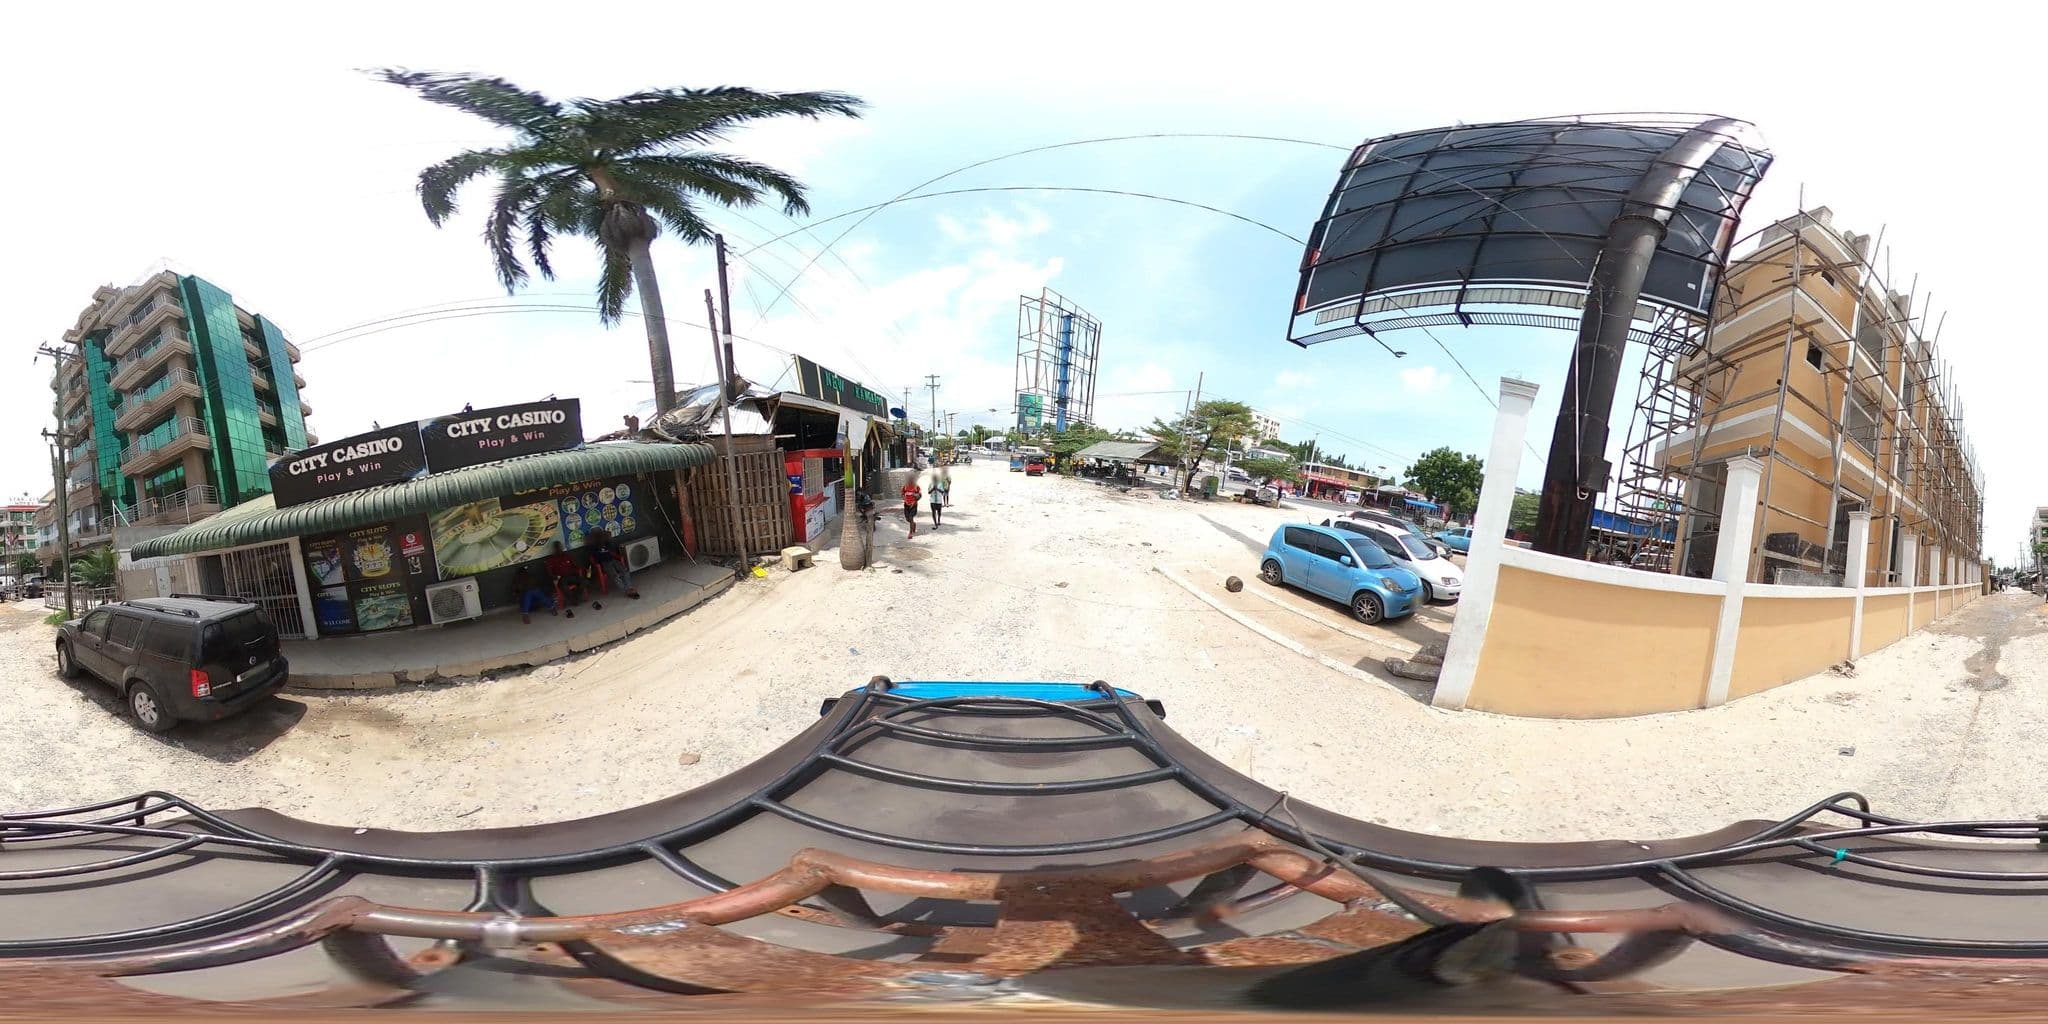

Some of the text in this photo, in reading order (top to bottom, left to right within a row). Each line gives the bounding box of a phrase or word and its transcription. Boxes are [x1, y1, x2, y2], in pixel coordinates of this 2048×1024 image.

[825, 370, 845, 393] NEW
[447, 410, 566, 438] CITY CASINO
[478, 430, 545, 449] Play & Win
[288, 437, 402, 475] CITY CASINO
[317, 461, 381, 484] Play & Win
[549, 485, 571, 497] Play
[572, 484, 580, 493] &
[582, 480, 601, 490] Win
[349, 525, 389, 538] CITY SLOTS
[360, 582, 401, 593] CITY SLOTS
